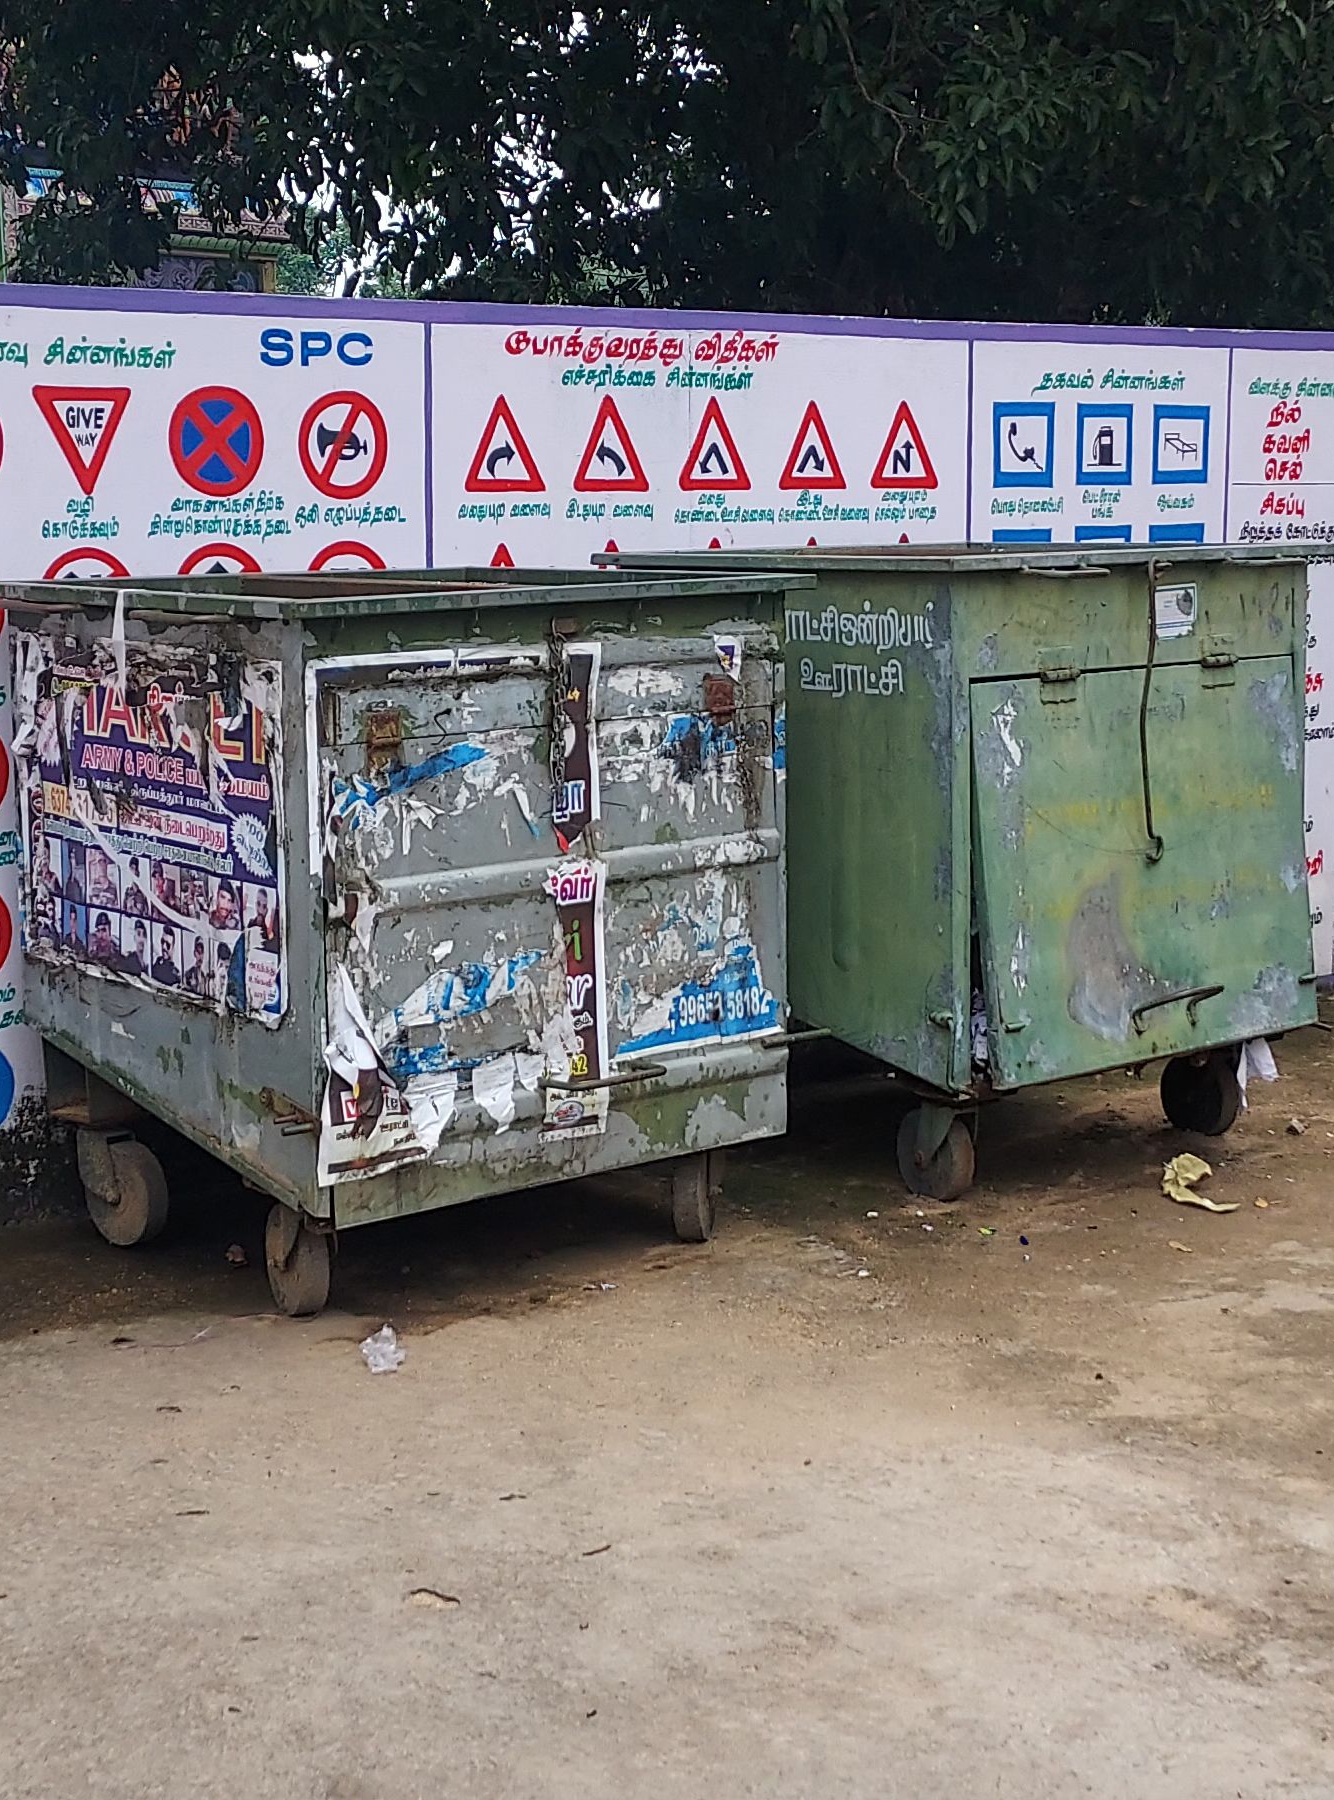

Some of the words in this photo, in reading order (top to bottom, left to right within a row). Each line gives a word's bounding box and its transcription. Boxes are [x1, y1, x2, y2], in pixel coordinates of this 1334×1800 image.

[43, 336, 177, 369] சின்னங்கள்
[259, 329, 373, 367] SPC
[504, 327, 683, 367] போக்குவரத்து
[694, 329, 780, 370] விதிகள்
[561, 364, 656, 391] எச்சரிக்கை
[1030, 368, 1095, 397] தகவல்
[1099, 367, 1186, 391] சின்னங்கள்
[66, 406, 105, 430] GIVE
[1266, 400, 1302, 428] நில்
[74, 432, 98, 448] WAY
[1262, 428, 1311, 454] கவனி
[1264, 454, 1303, 481] செல்
[66, 495, 94, 518] வழி
[295, 503, 320, 528] ஒலி
[1260, 491, 1306, 519] சிகப்பு
[41, 516, 120, 540] கொடுக்கவும்
[800, 657, 905, 699] ஊராட்சி
[80, 743, 122, 772] ARMY
[124, 755, 135, 777] &
[137, 756, 184, 783] POLICE
